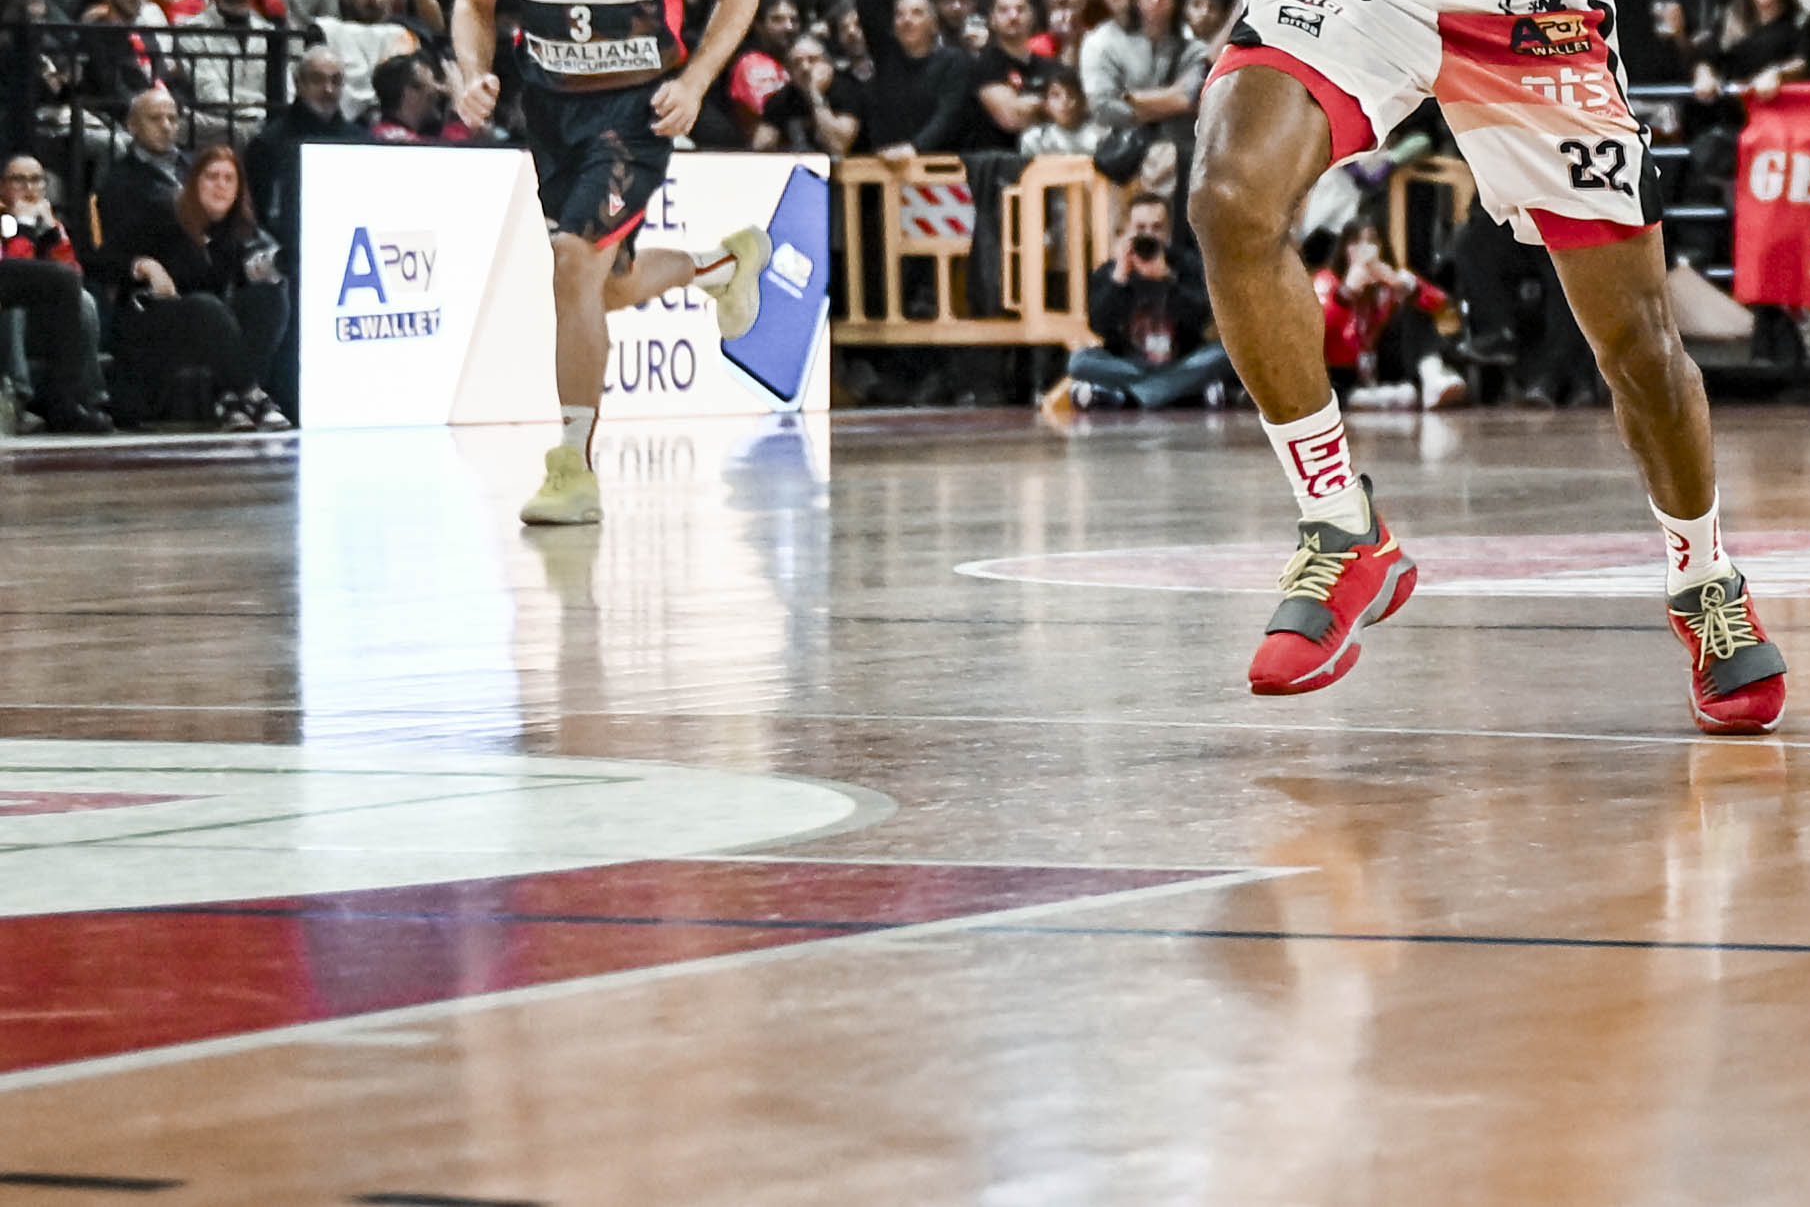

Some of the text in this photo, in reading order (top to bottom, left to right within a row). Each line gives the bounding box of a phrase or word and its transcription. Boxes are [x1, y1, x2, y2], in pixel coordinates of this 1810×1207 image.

[569, 5, 592, 43] 3
[545, 41, 654, 60] ITALIANA
[1559, 140, 1635, 195] 22
